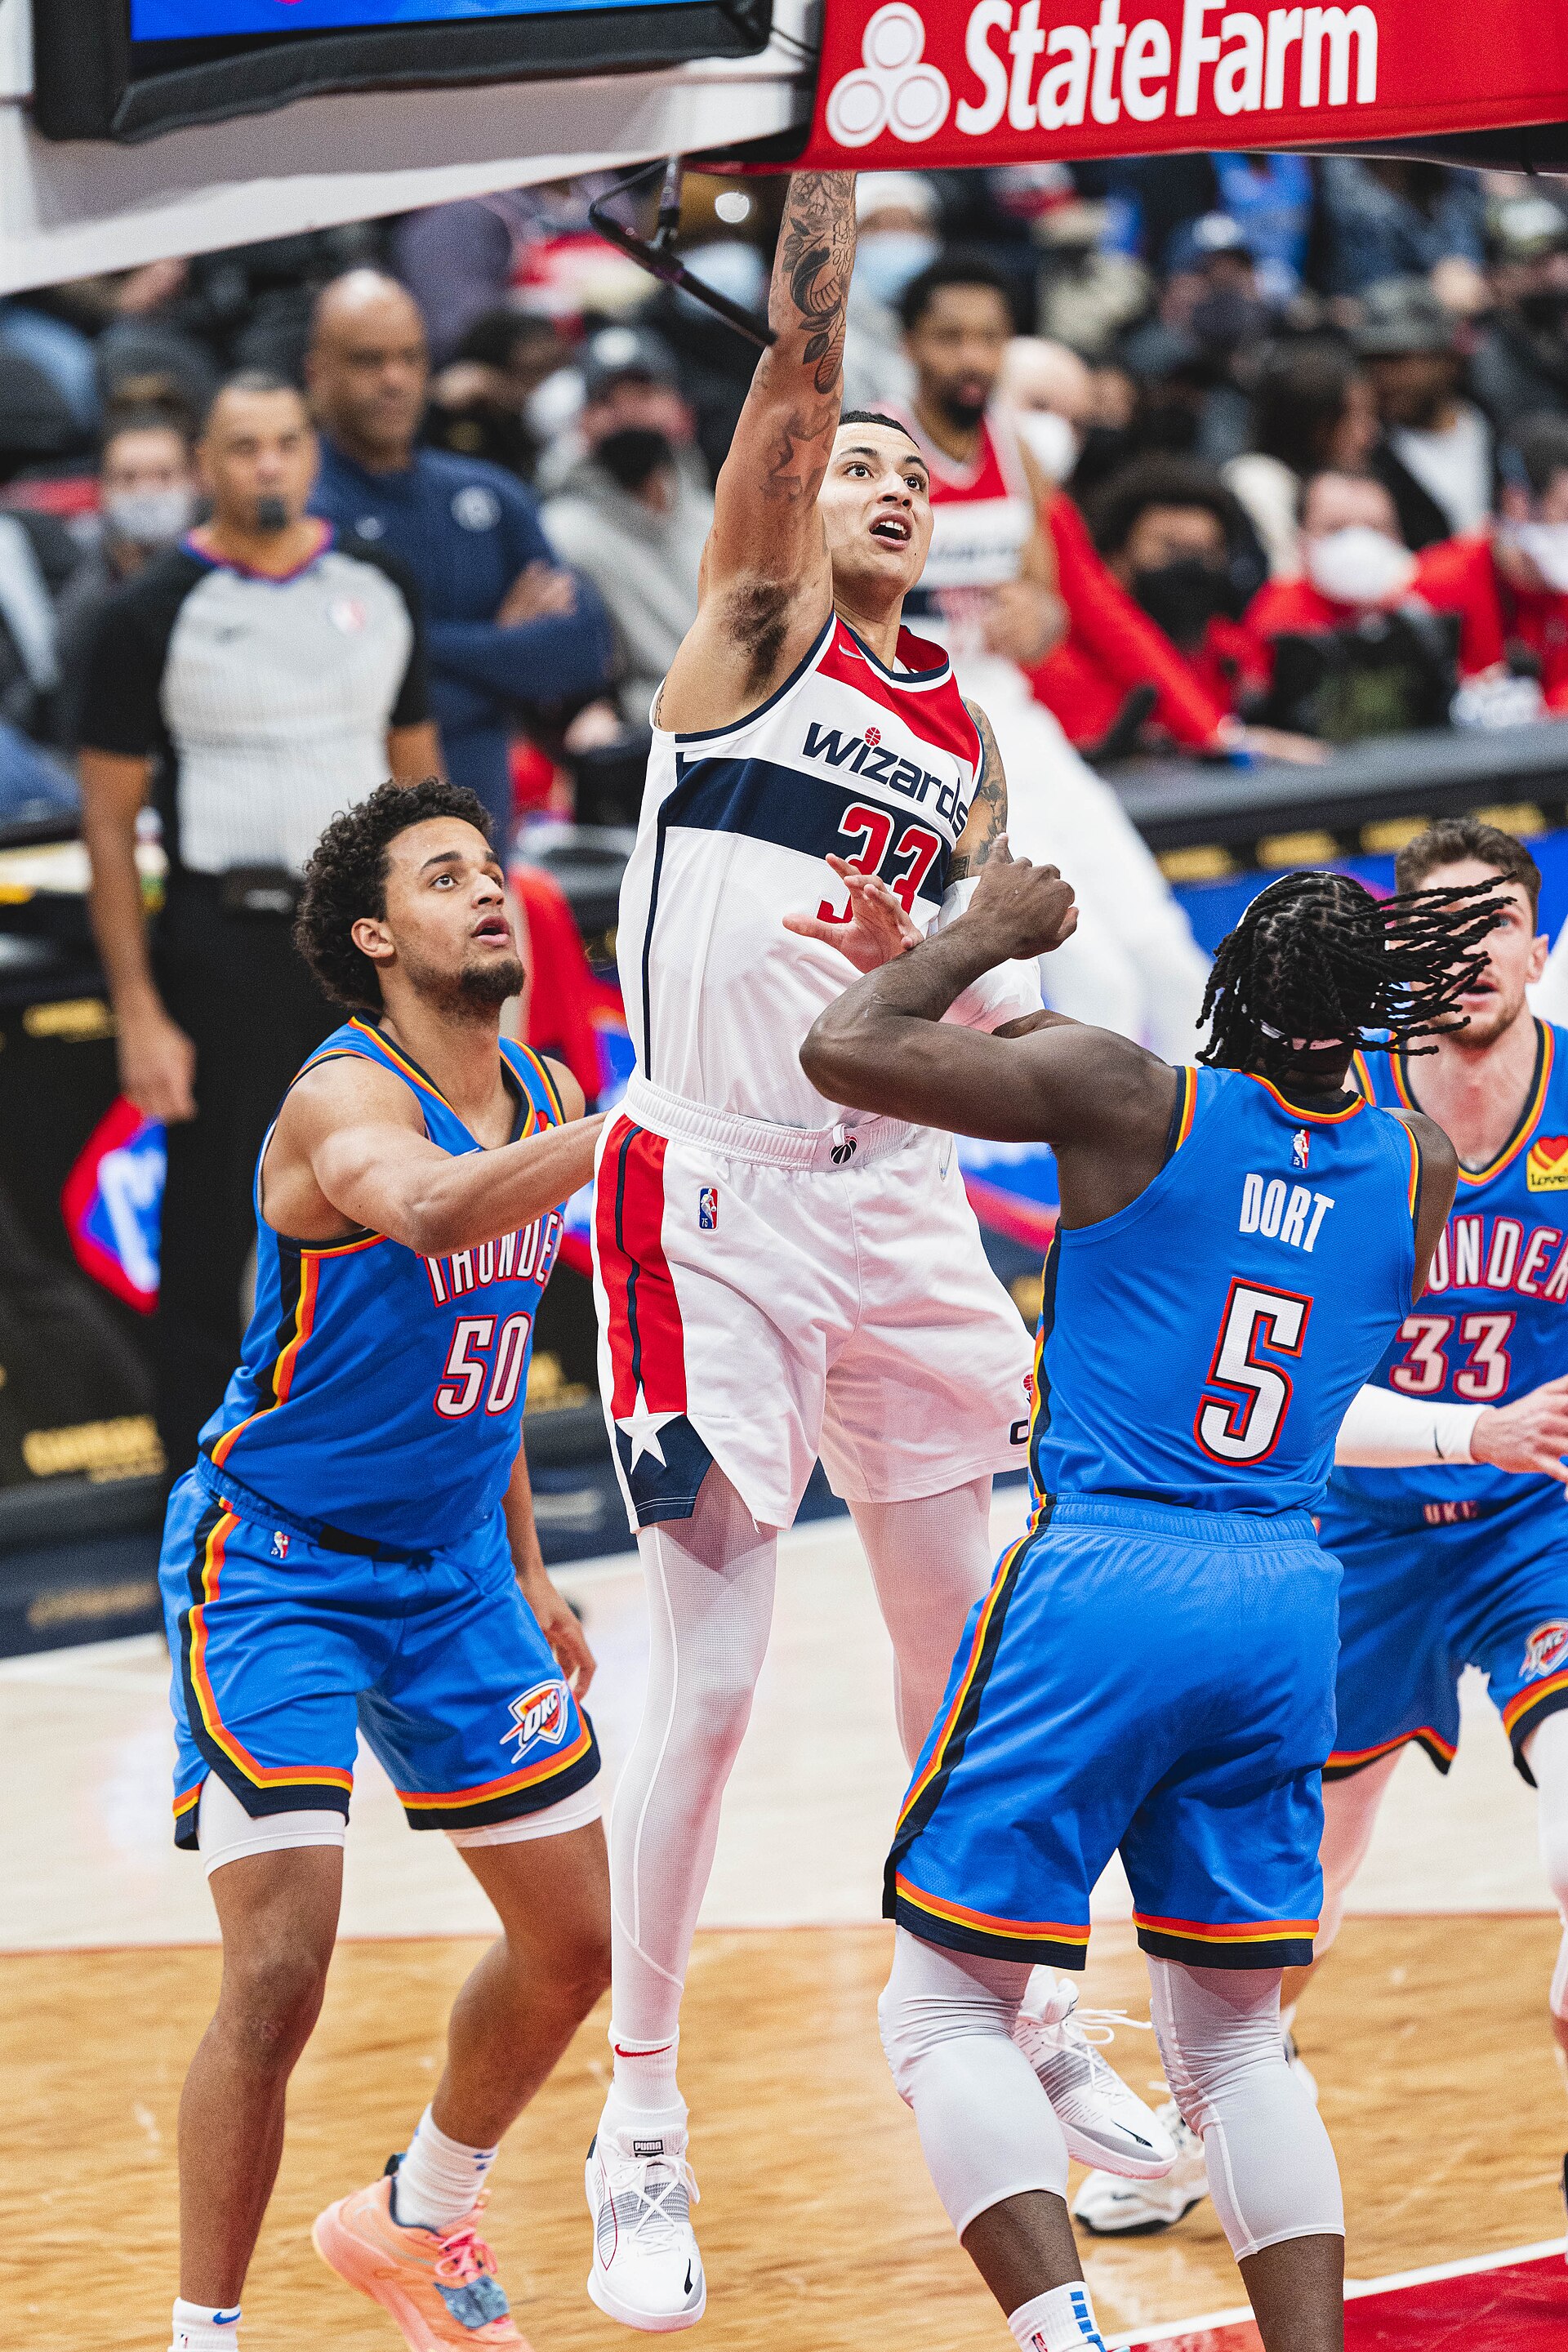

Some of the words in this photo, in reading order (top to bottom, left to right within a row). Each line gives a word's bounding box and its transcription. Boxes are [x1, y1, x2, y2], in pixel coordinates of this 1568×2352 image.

[701, 1218, 709, 1227] 75
[1238, 1173, 1335, 1253] DORT
[433, 1311, 532, 1420] 50
[1193, 1276, 1313, 1467] 5
[1390, 1312, 1517, 1401] 33
[635, 2141, 662, 2151] PUMA
